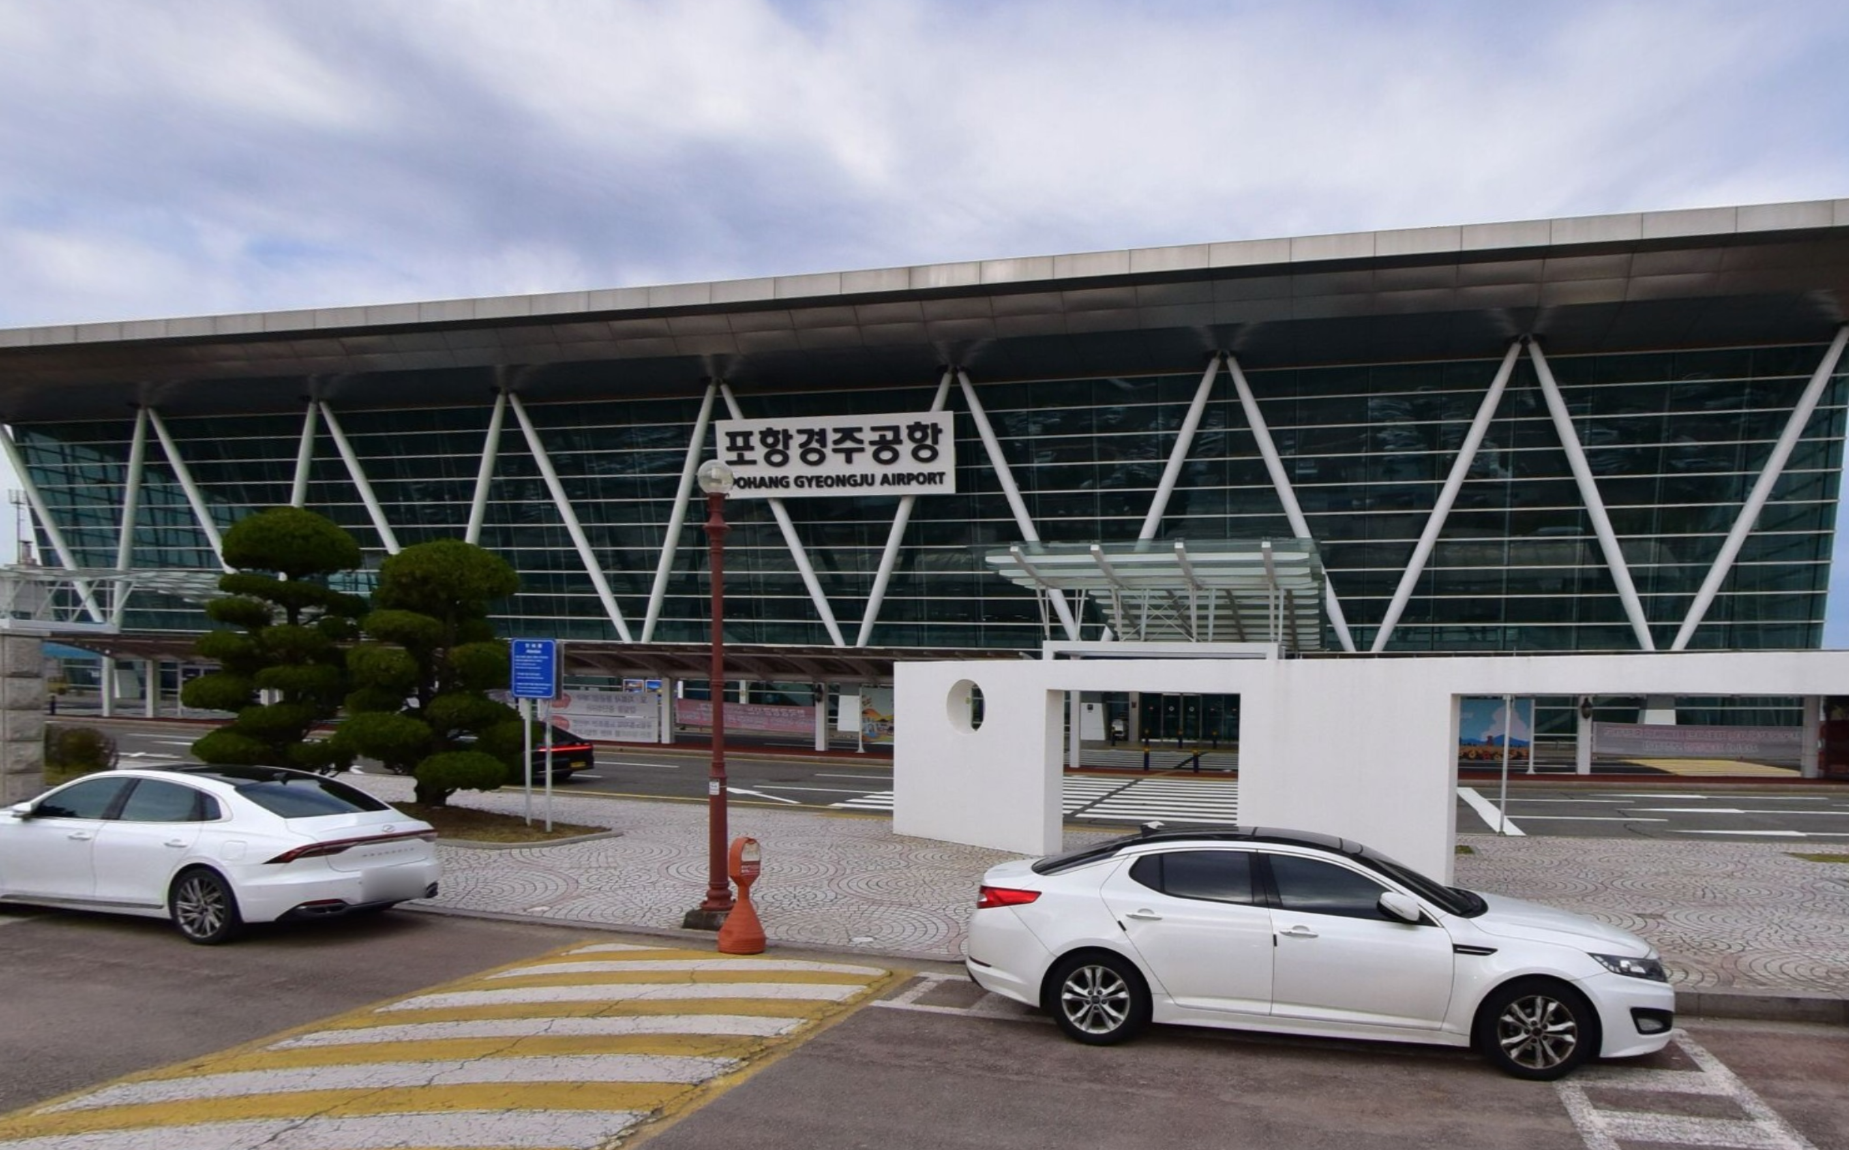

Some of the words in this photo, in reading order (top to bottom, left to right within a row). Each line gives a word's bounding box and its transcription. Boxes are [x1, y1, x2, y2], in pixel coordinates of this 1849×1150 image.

[724, 421, 943, 468] 포항경주공항
[794, 473, 875, 489] GYEONGJU
[880, 471, 946, 487] AIRPORT
